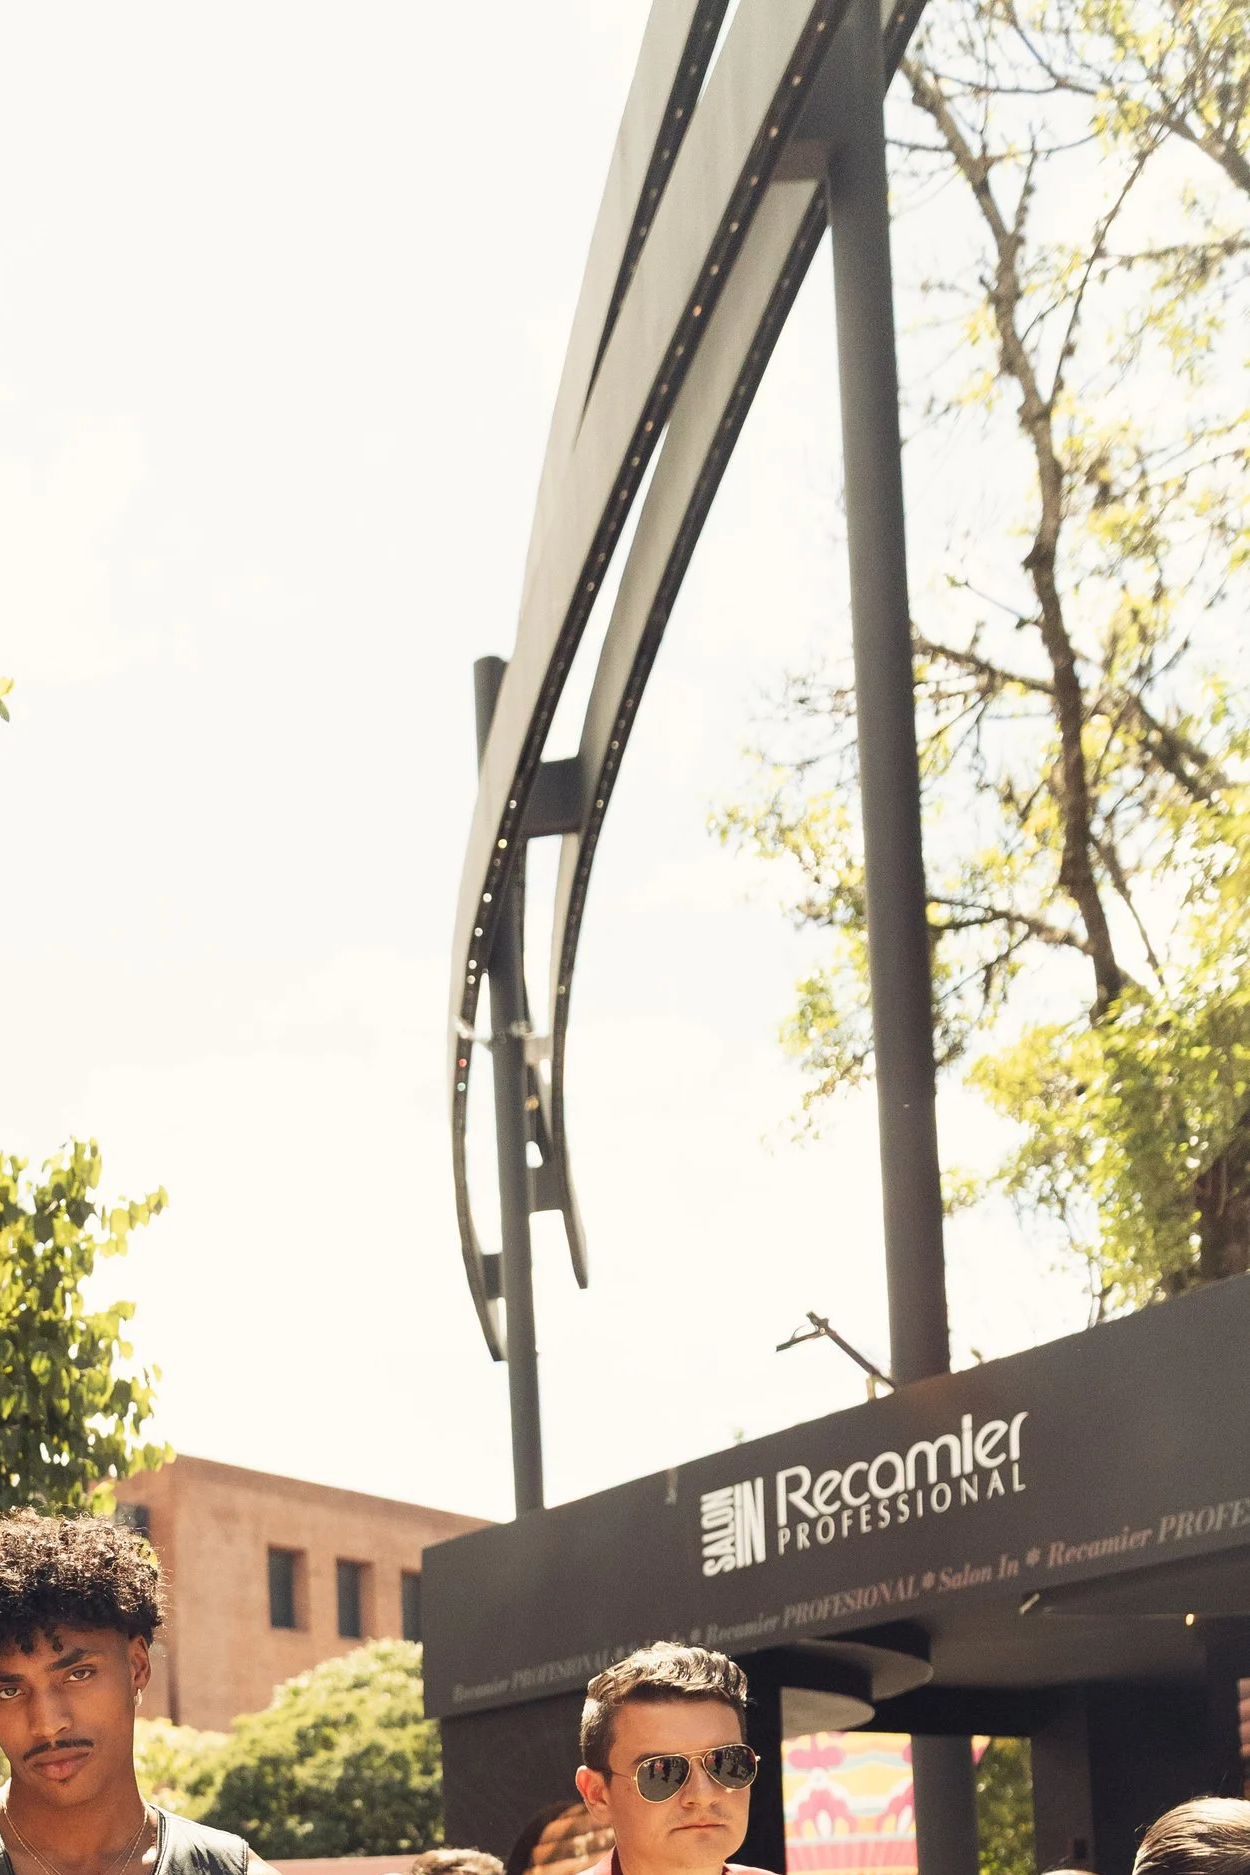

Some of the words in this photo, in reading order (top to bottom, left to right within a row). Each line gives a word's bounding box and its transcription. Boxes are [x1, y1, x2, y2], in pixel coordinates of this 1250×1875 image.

[776, 1411, 1029, 1528] Recamier
[777, 1462, 1026, 1555] PROFESSIONAL
[700, 1485, 737, 1577] SALON
[734, 1476, 766, 1569] IN
[939, 1562, 992, 1593] Salon
[999, 1553, 1019, 1579] In
[1047, 1526, 1153, 1569] Recamier
[1157, 1497, 1250, 1544] PROFE
